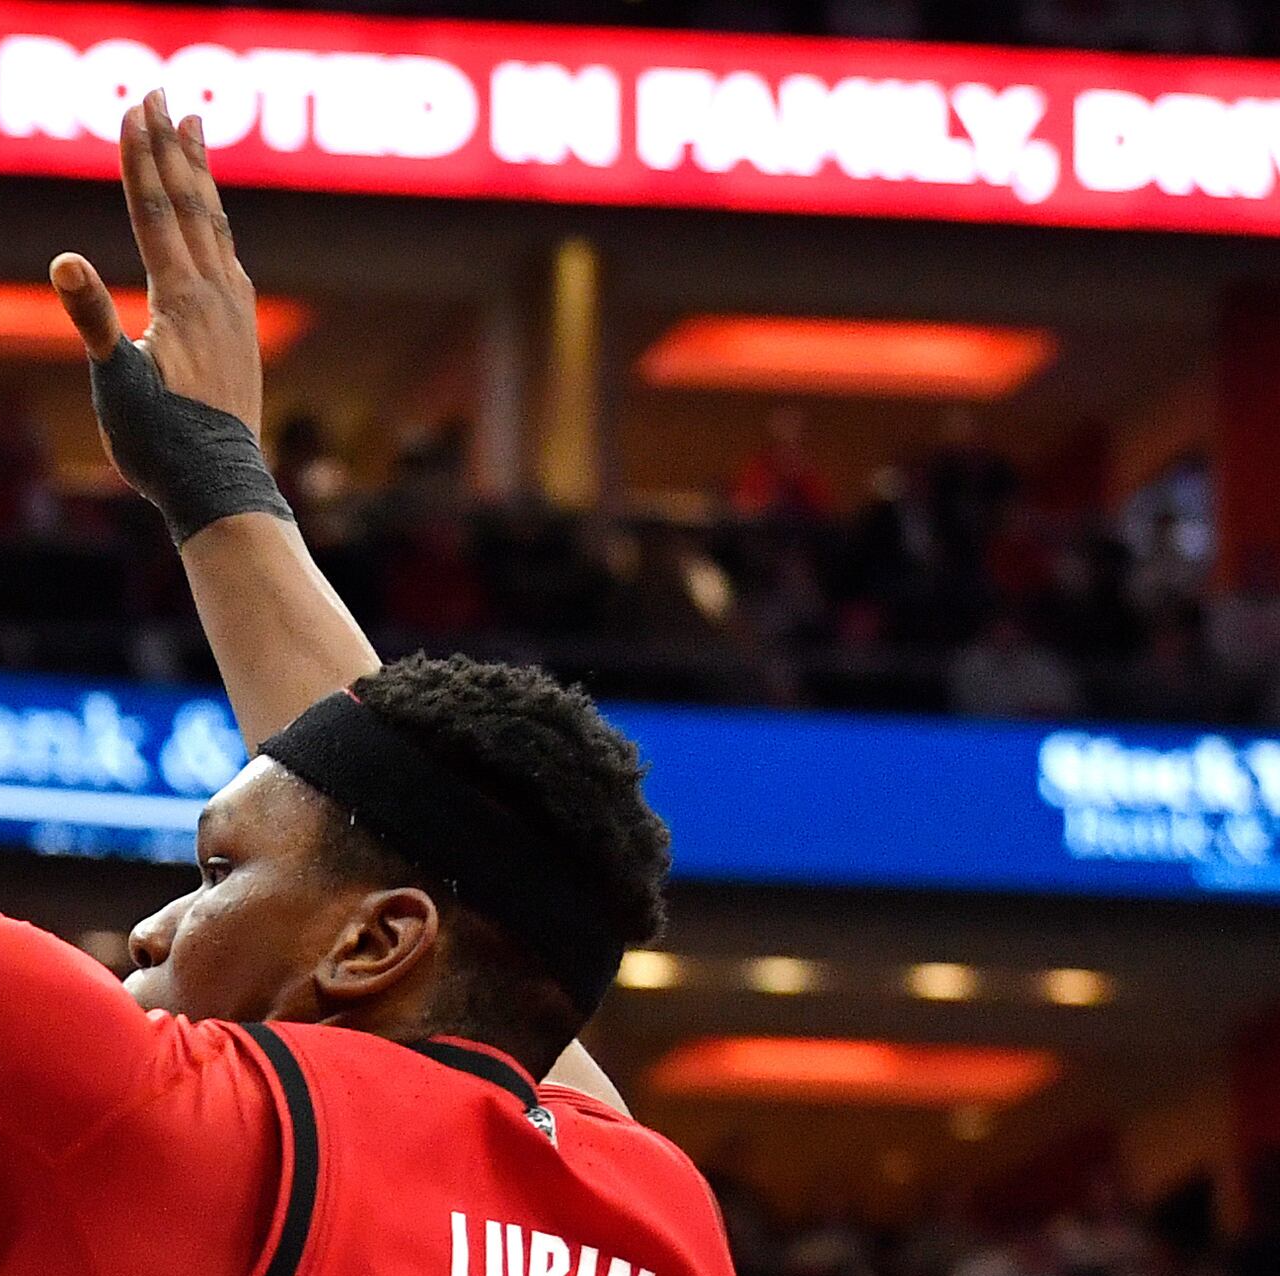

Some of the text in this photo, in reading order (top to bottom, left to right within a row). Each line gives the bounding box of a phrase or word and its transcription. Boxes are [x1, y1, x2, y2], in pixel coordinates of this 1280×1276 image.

[490, 61, 620, 167] IN
[636, 68, 1060, 204] FAMILY,
[1073, 88, 1280, 199] DRI
